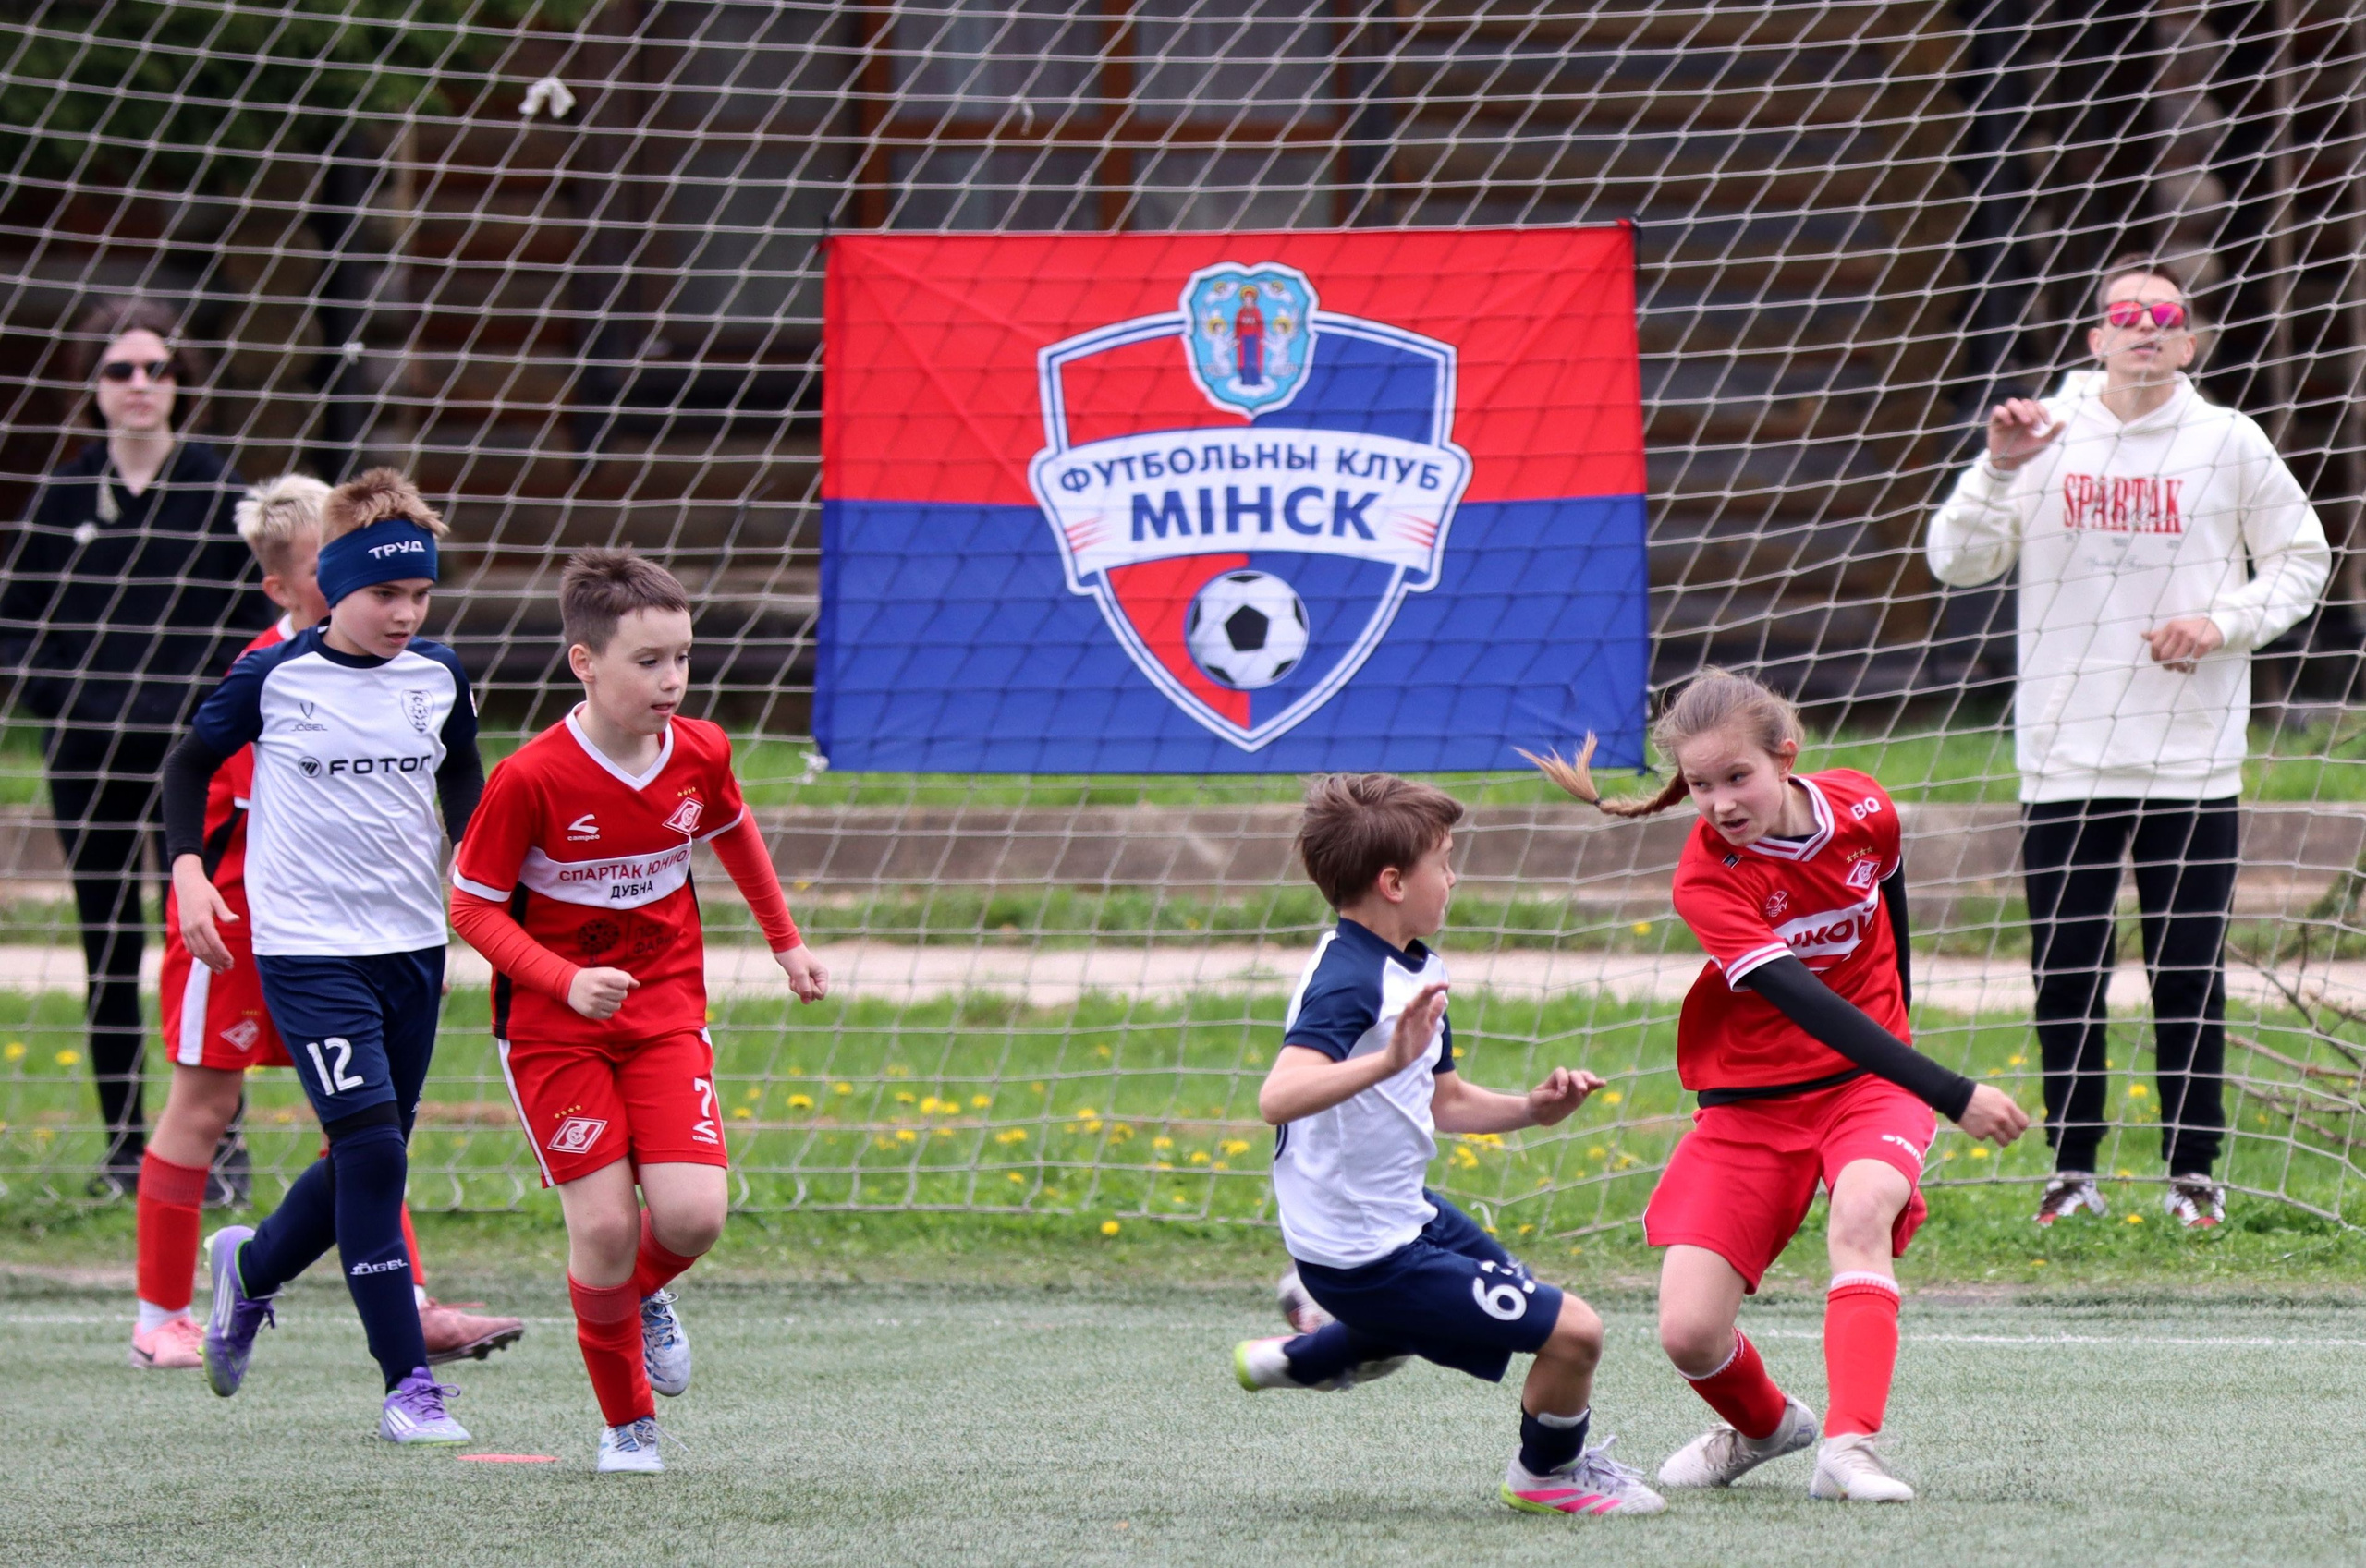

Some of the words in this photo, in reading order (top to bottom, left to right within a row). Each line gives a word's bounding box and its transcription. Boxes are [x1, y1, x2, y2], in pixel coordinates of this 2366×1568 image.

[1060, 444, 1317, 492] ФУТБОЛЬНЫ
[1337, 448, 1442, 490] КЛУБ
[1132, 486, 1380, 541] МІНСК
[2064, 473, 2182, 533] SPARTAK
[368, 541, 426, 559] ТРУД
[1850, 797, 1882, 820] BQ
[558, 864, 644, 881] СПАРТАК
[610, 880, 653, 899] ДУБНА
[306, 1037, 364, 1096] 12
[694, 1077, 713, 1118] 7
